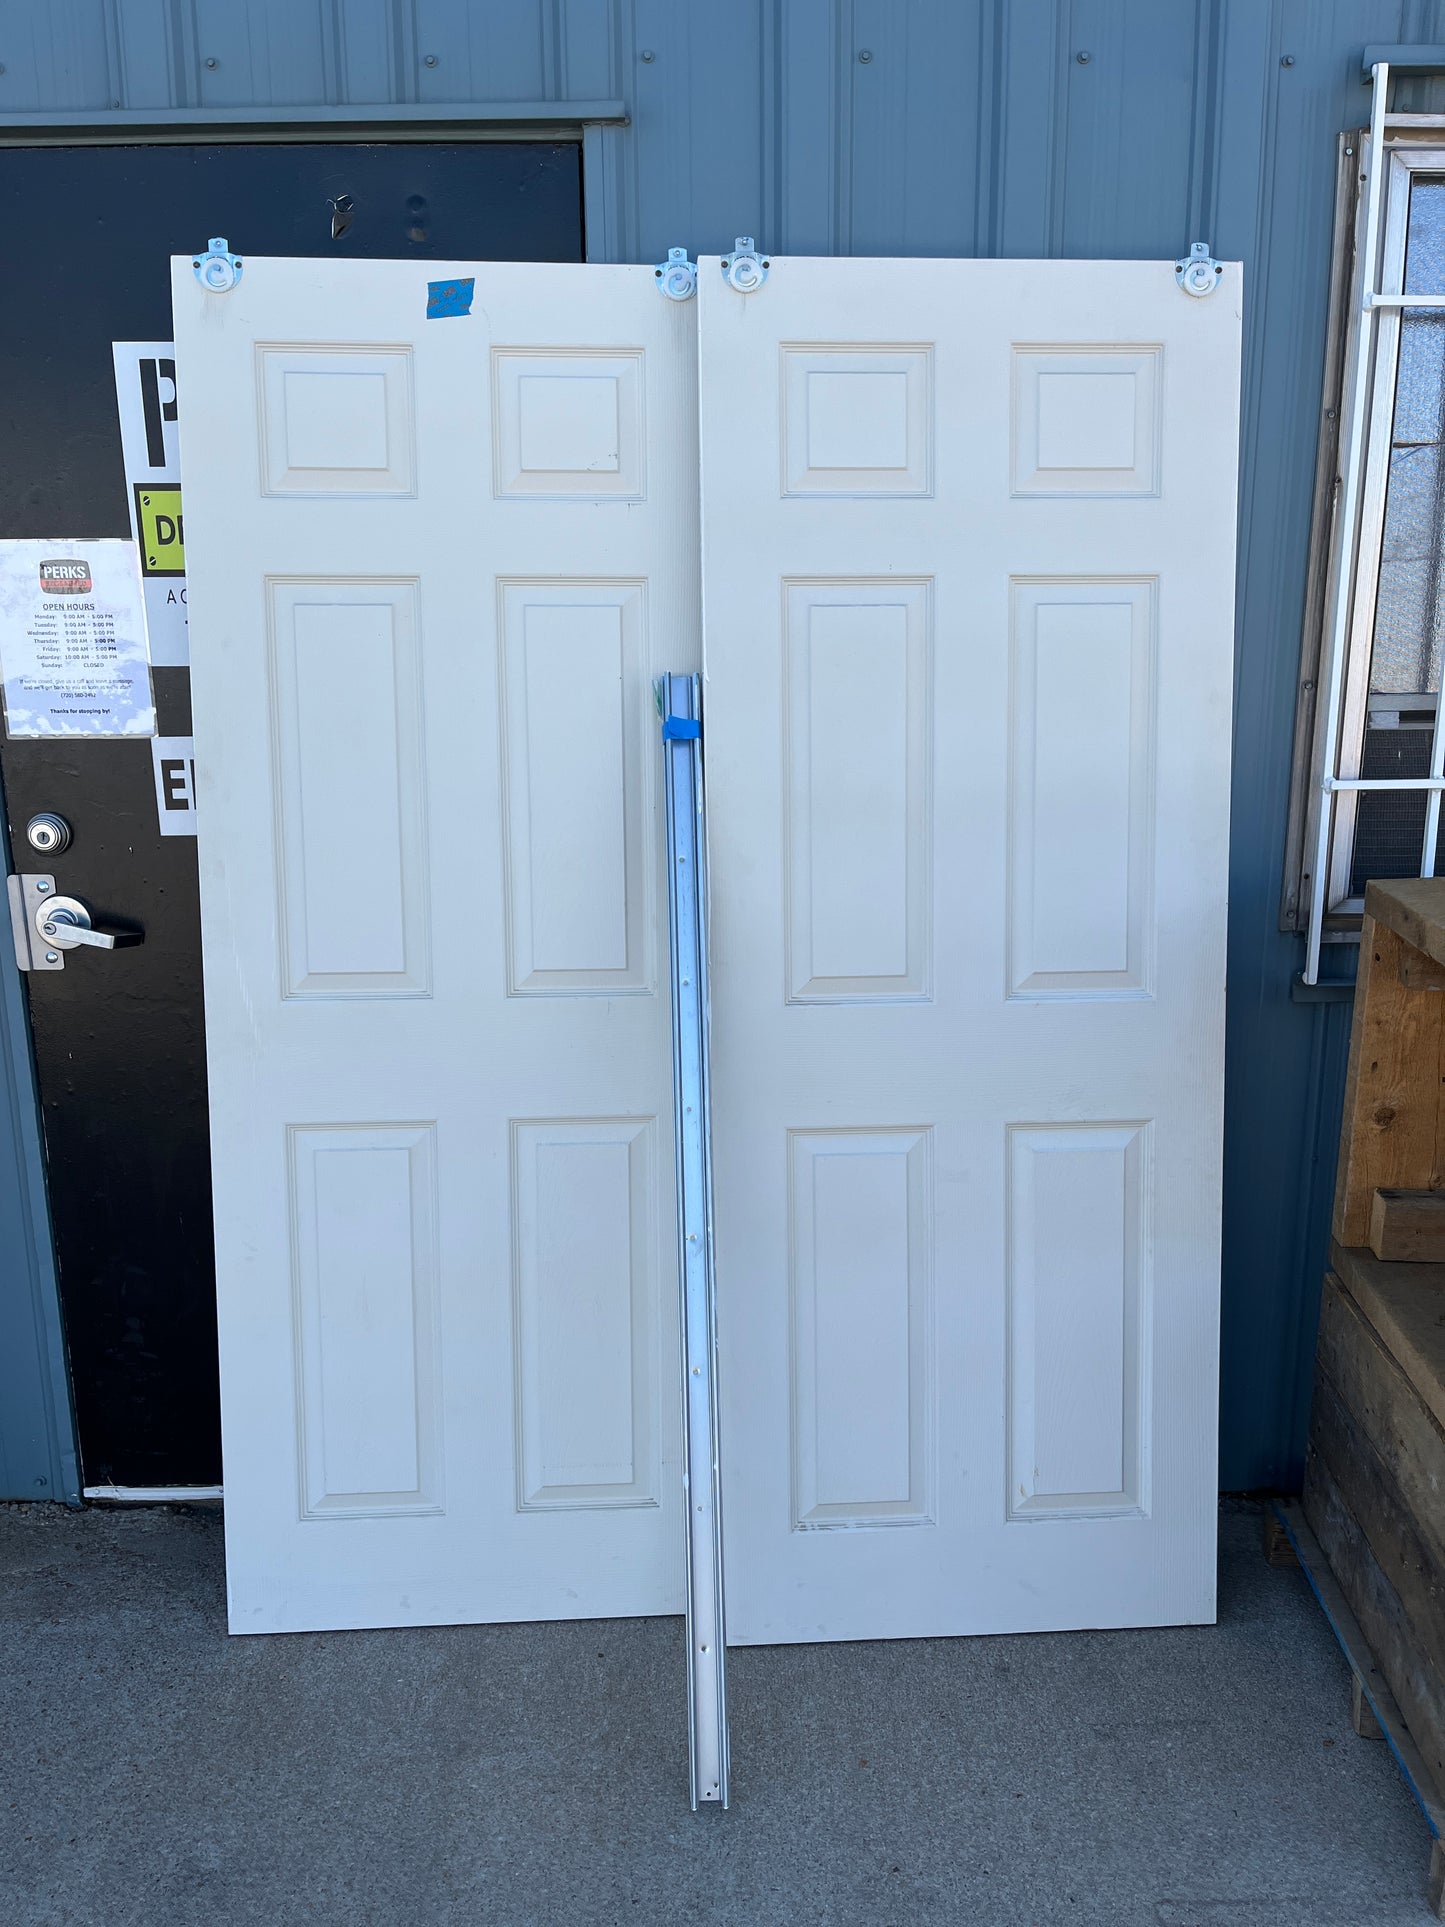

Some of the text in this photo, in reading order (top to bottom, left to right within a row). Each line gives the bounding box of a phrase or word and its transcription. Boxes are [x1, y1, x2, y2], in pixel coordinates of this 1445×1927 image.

[43, 566, 86, 578] PERKS
[43, 603, 94, 611] OPEN HOURS
